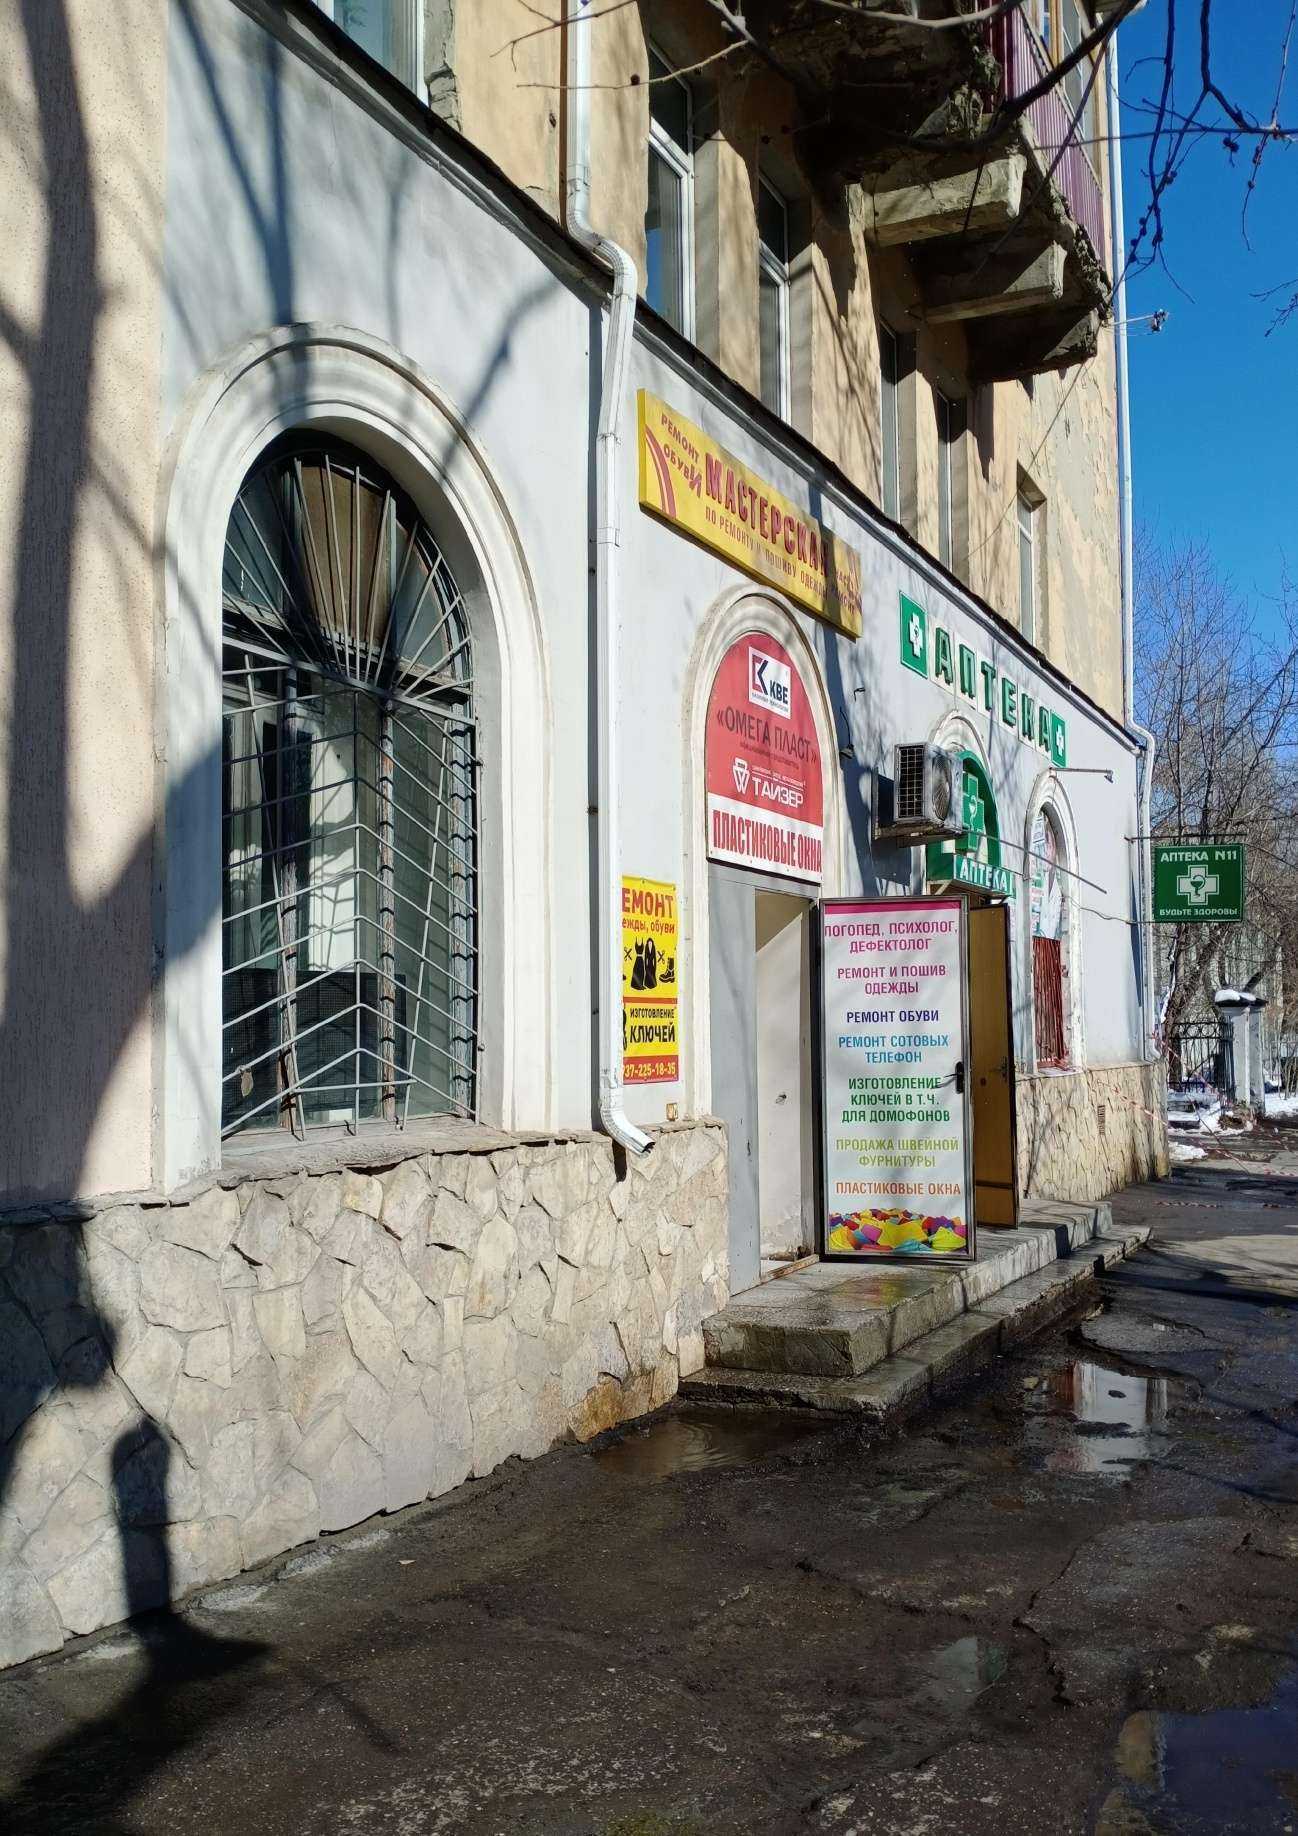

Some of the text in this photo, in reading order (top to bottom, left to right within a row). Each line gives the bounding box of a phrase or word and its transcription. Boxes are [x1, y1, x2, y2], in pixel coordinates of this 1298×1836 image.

[661, 413, 700, 464] РЕМОНТ
[704, 452, 828, 579] МАСТЕРСКАЯ
[705, 506, 717, 526] ПО
[719, 516, 754, 551] РЕМОНТУ
[765, 548, 797, 578] ПОШИВУ
[935, 626, 1051, 753] АПТЕКА
[712, 809, 822, 873] ПЛАСТИКОВЫЕ ОКНА
[1160, 851, 1209, 863] АПТЕКА
[960, 858, 1008, 892] АПТЕКА
[1160, 908, 1238, 916] БУДЬТЕ ЗДОРОВЫ
[650, 919, 675, 936] обуви
[850, 938, 933, 954] ДЕФЕКТОЛОГ
[838, 965, 946, 980] РЕМОНТ И ПОШИВ
[865, 982, 919, 996] ОДЕЖДЫ
[630, 1007, 675, 1019] ИЗГОТОВЛЕНИЕ
[847, 1010, 939, 1023] РЕМОНТ ОБУВИ
[630, 1021, 675, 1043] КЛЮЧЕЙ
[838, 1034, 949, 1049] РЕМОНТ СОТОВЫХ
[865, 1051, 922, 1064] ТЕЛЕФОН
[848, 1077, 942, 1091] ИЗГОТОВЛЕНИЕ
[850, 1092, 901, 1106] КЛЮЧЕЙ
[905, 1094, 913, 1106] В
[841, 1109, 950, 1124] ДЛЯ ДОМОФОНОВ
[836, 1136, 959, 1152] ПРОДАЖА ШВЕЙНОЙ
[859, 1155, 936, 1168] ФУРНИТУРЫ
[836, 1182, 961, 1195] ПЛАСТИКОВЫЕ ОКНА
